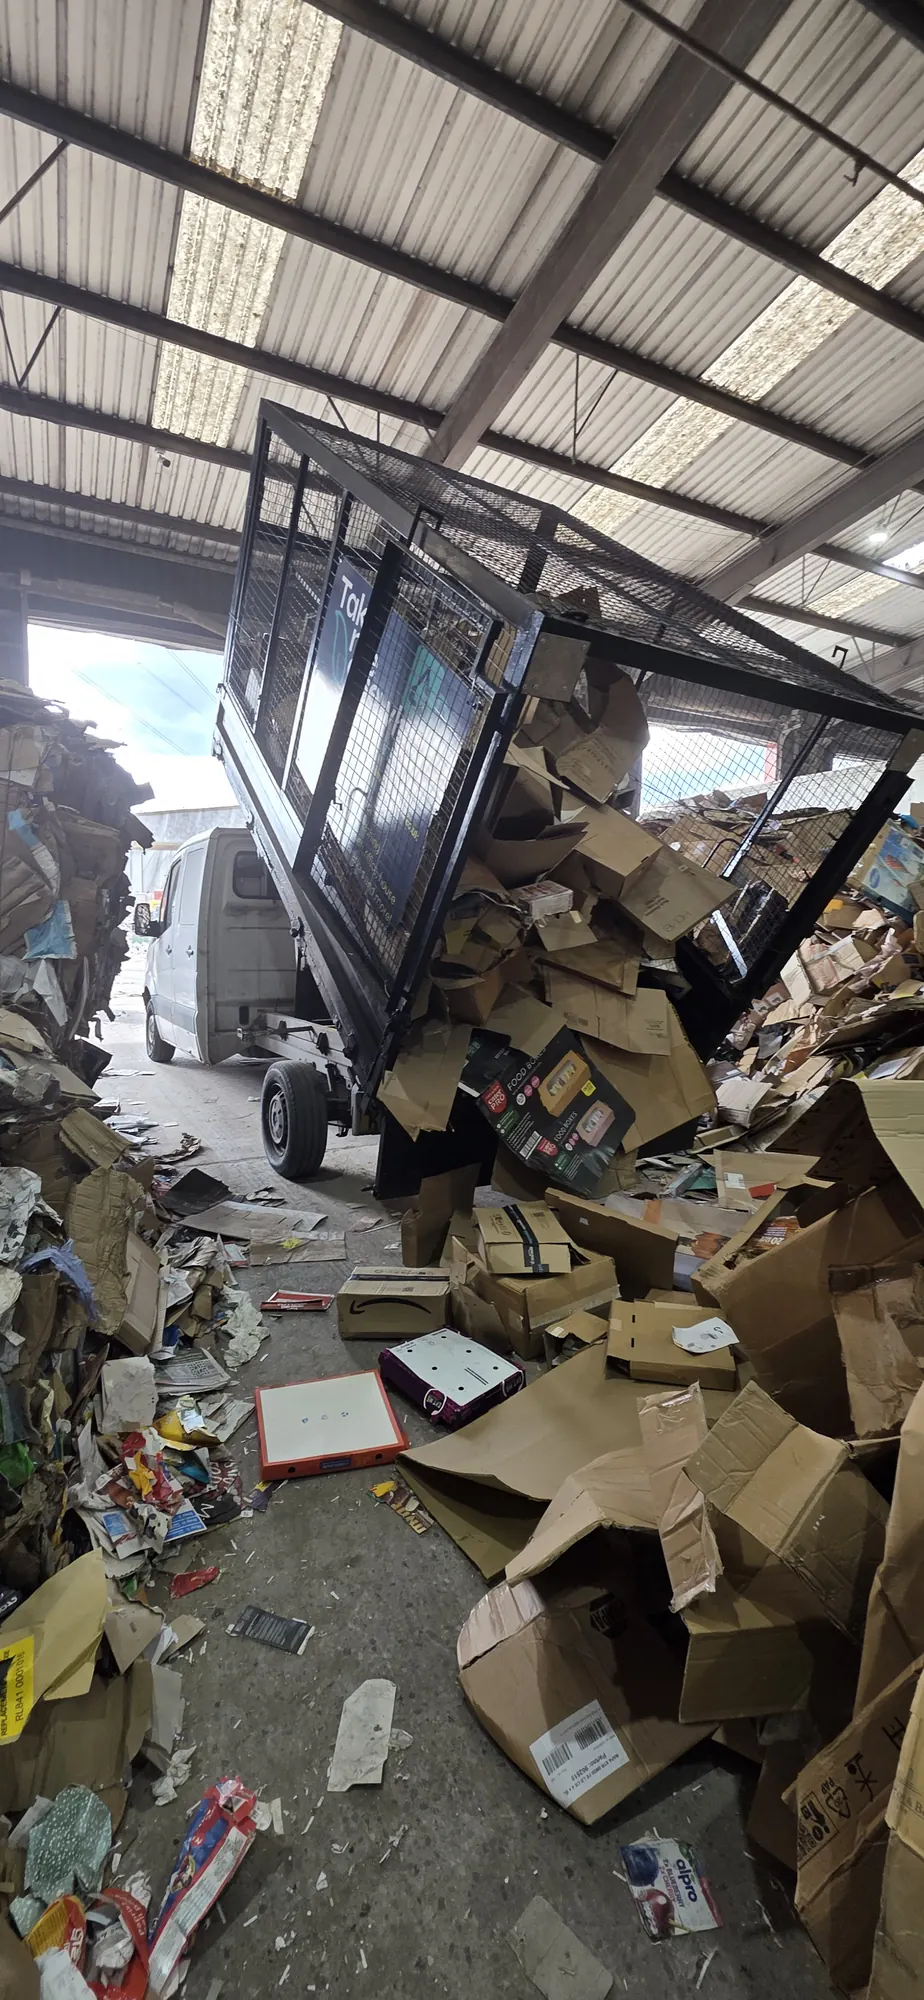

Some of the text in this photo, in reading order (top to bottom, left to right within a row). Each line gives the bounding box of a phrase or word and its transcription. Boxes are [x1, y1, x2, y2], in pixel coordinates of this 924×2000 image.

[340, 575, 368, 628] Tak
[507, 1067, 527, 1091] FOOD
[770, 1236, 784, 1245] 20
[821, 1777, 836, 1794] PAP
[665, 1867, 686, 1908] BLUEBERRY
[676, 1858, 698, 1903] alpro
